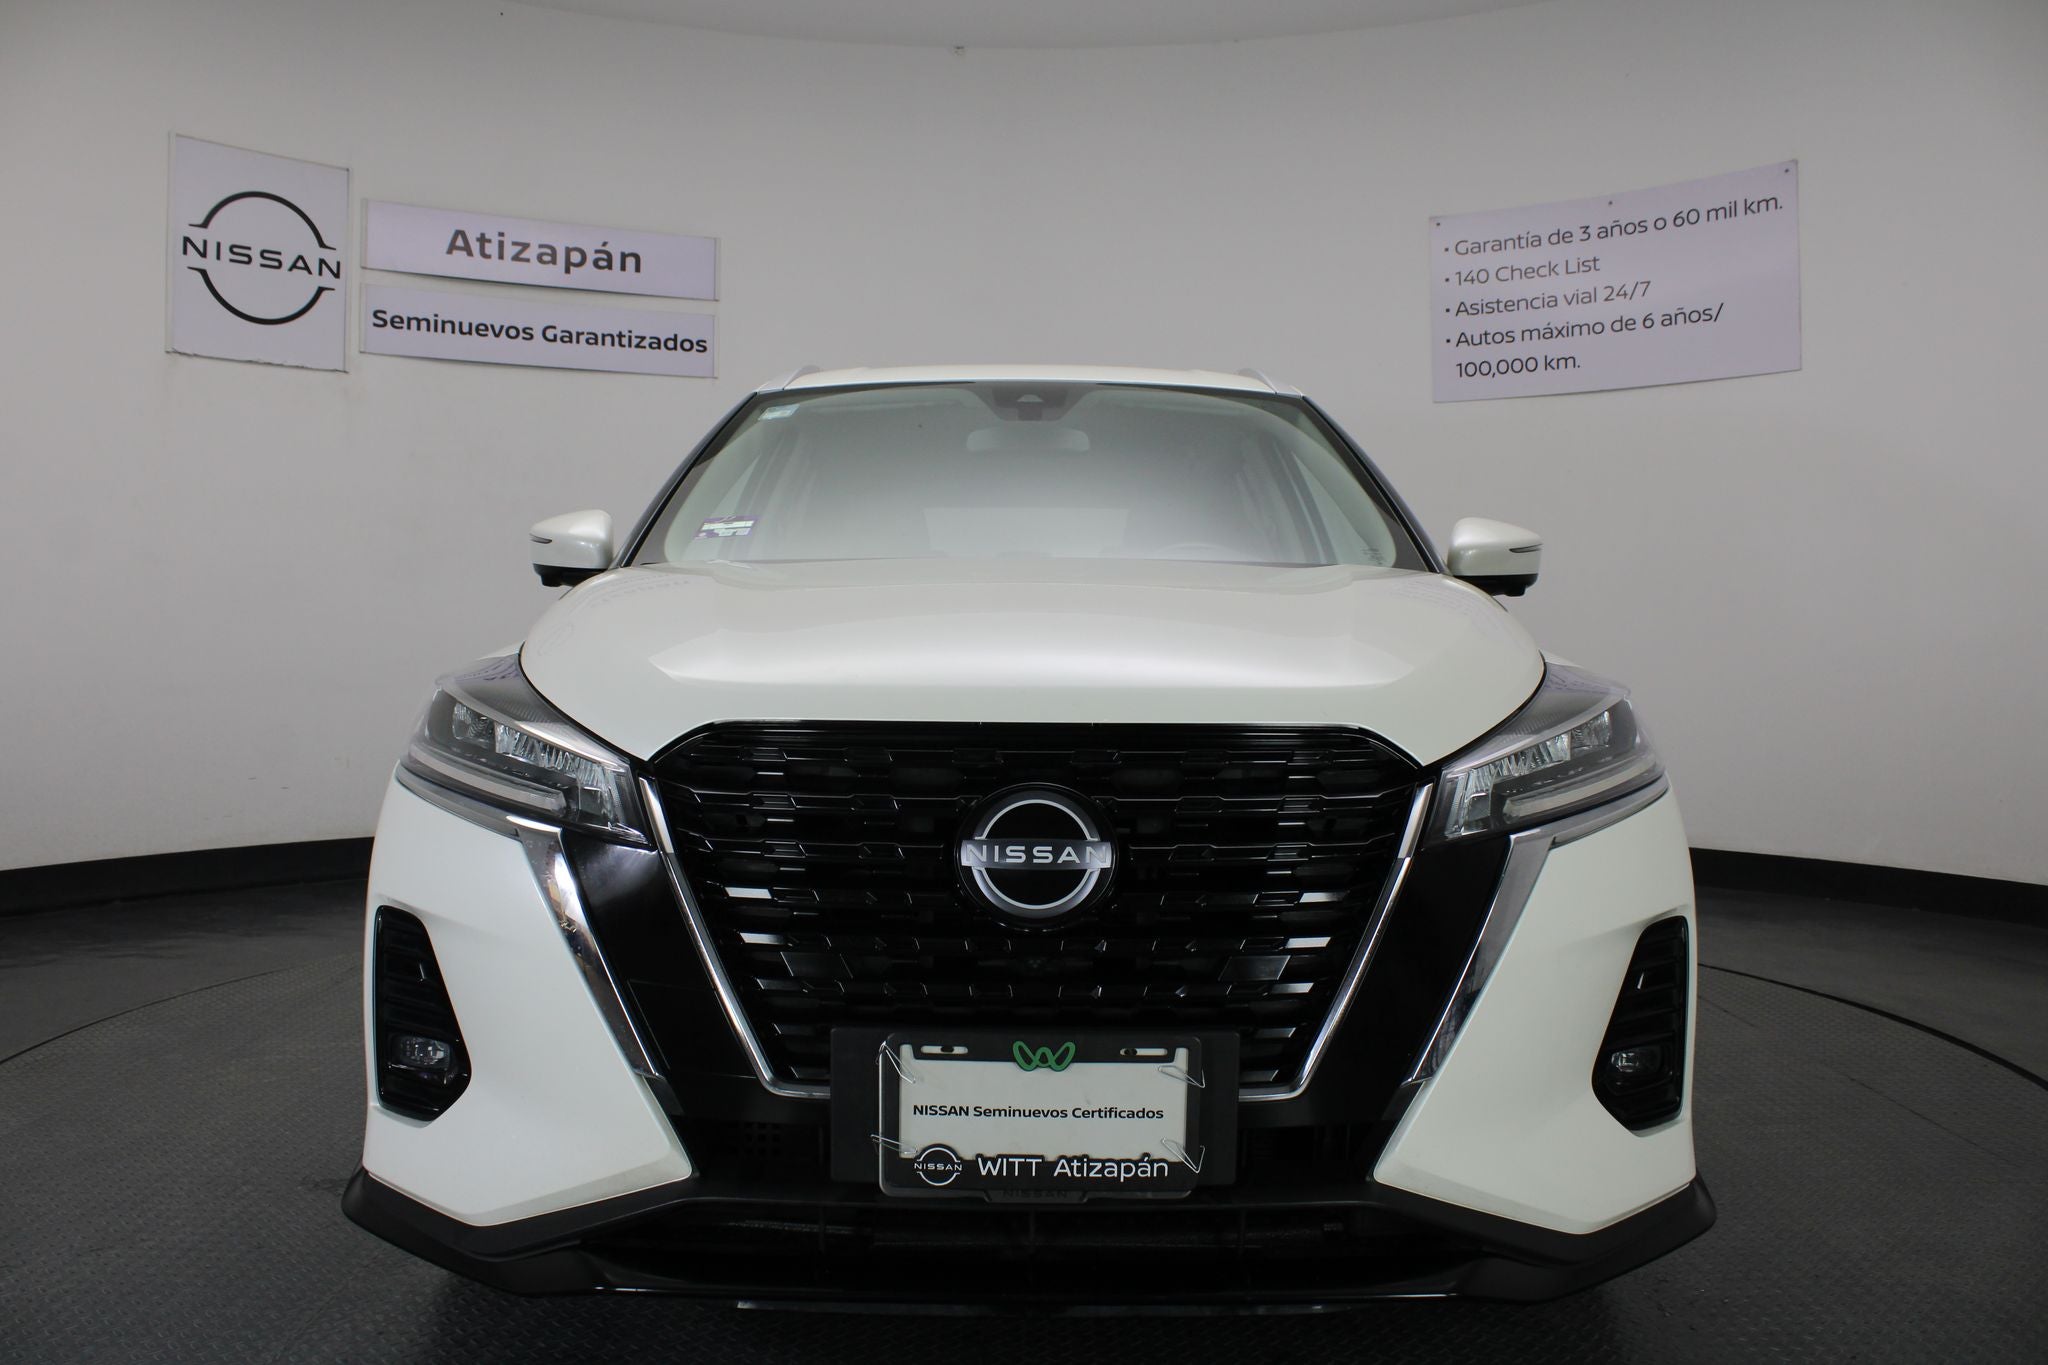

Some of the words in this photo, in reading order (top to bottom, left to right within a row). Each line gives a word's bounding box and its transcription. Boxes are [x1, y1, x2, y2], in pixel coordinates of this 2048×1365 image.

[1454, 231, 1542, 256] Garantía
[1548, 227, 1574, 245] de
[1579, 225, 1591, 242] 3
[1597, 219, 1648, 240] años
[1653, 216, 1667, 231] o
[1673, 208, 1701, 228] 60
[1706, 199, 1738, 223] mil
[1743, 196, 1783, 216] km.
[183, 236, 341, 279] NISSAN
[446, 229, 642, 274] Atizapán
[1454, 269, 1490, 287] 140
[1495, 261, 1560, 283] Check
[1565, 256, 1601, 275] List
[1454, 293, 1559, 317] Asistencia
[1563, 287, 1597, 306] vial
[1603, 281, 1652, 302] 24/7
[372, 310, 534, 342] Seminuevos
[541, 325, 708, 353] Garantizados
[1455, 329, 1516, 348] Autos
[1521, 320, 1606, 343] máximo
[1610, 315, 1637, 333] de
[1642, 313, 1655, 330] 6
[1661, 302, 1725, 328] años/
[1455, 356, 1539, 379] 100,000
[1543, 354, 1582, 372] km.
[965, 844, 1107, 864] NISSAN
[913, 1105, 969, 1117] NISSAN
[973, 1106, 1068, 1119] Seminuevos
[1072, 1107, 1164, 1120] Certificados
[914, 1162, 963, 1171] NISSAN
[977, 1158, 1043, 1177] WITT
[1053, 1155, 1169, 1182] Atizapán
